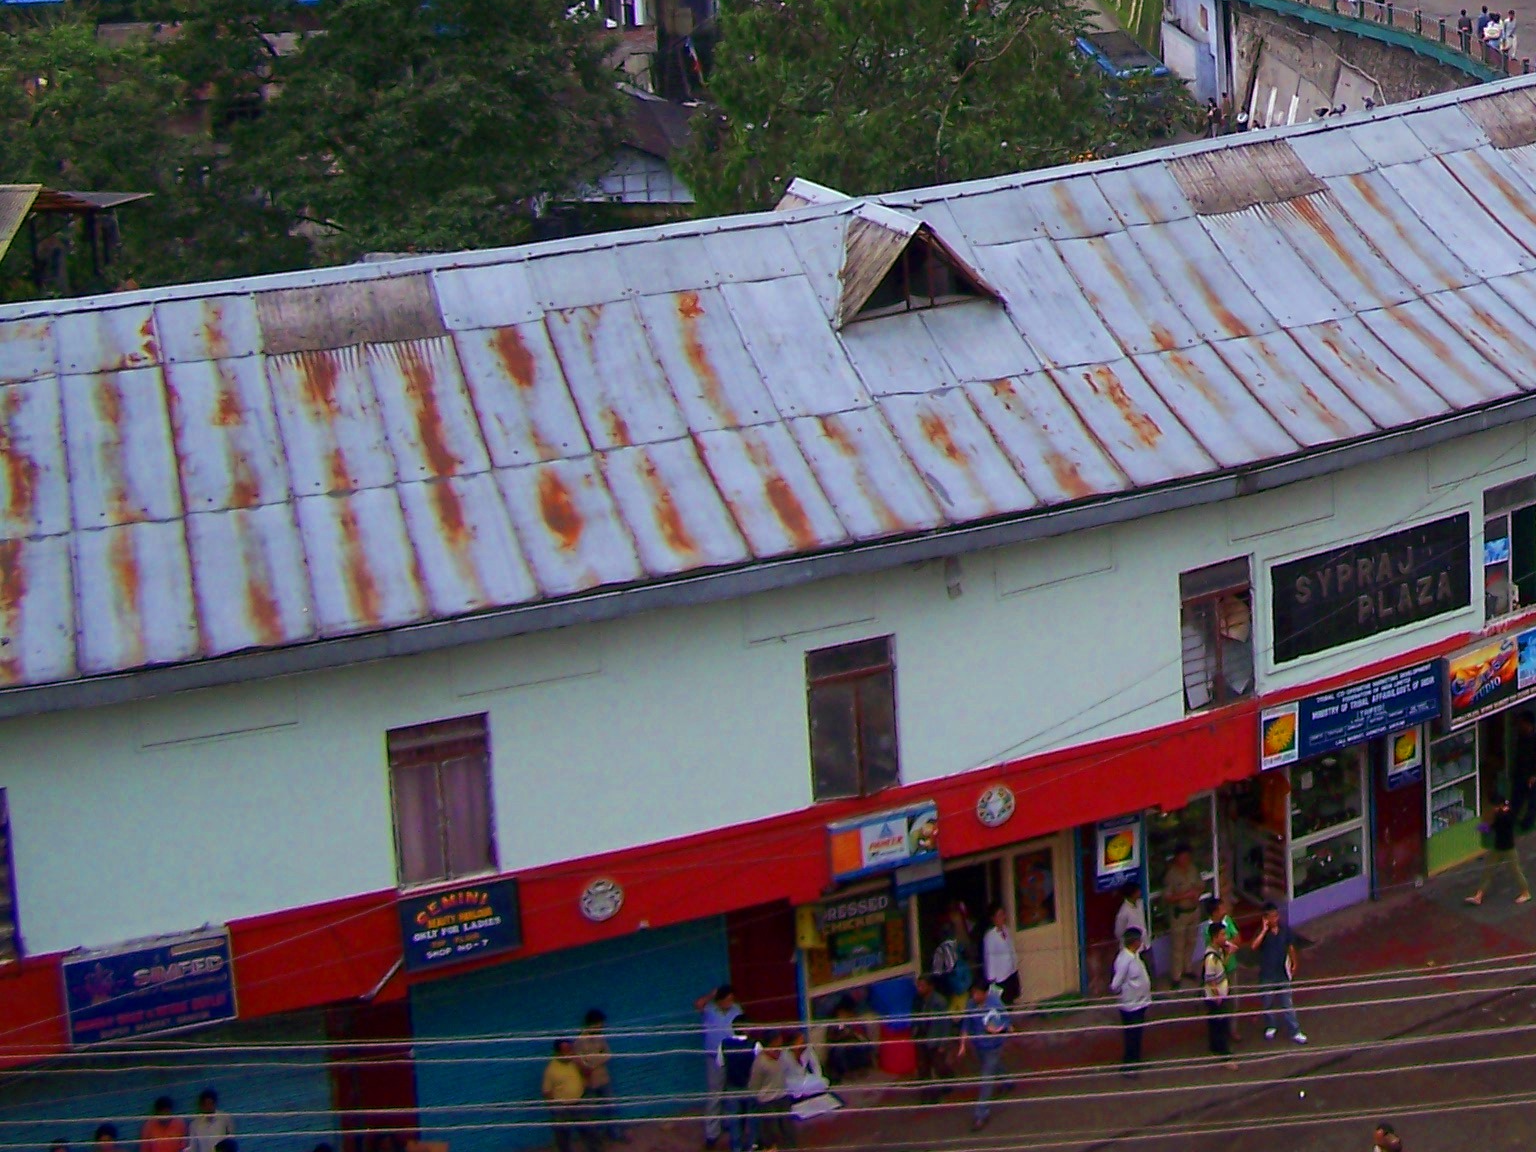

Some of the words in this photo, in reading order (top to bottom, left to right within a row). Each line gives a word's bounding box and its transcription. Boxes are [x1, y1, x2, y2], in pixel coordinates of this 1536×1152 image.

[1296, 546, 1414, 604] SYPRAJ
[1358, 571, 1451, 624] PLAZA
[441, 925, 459, 937] FOR
